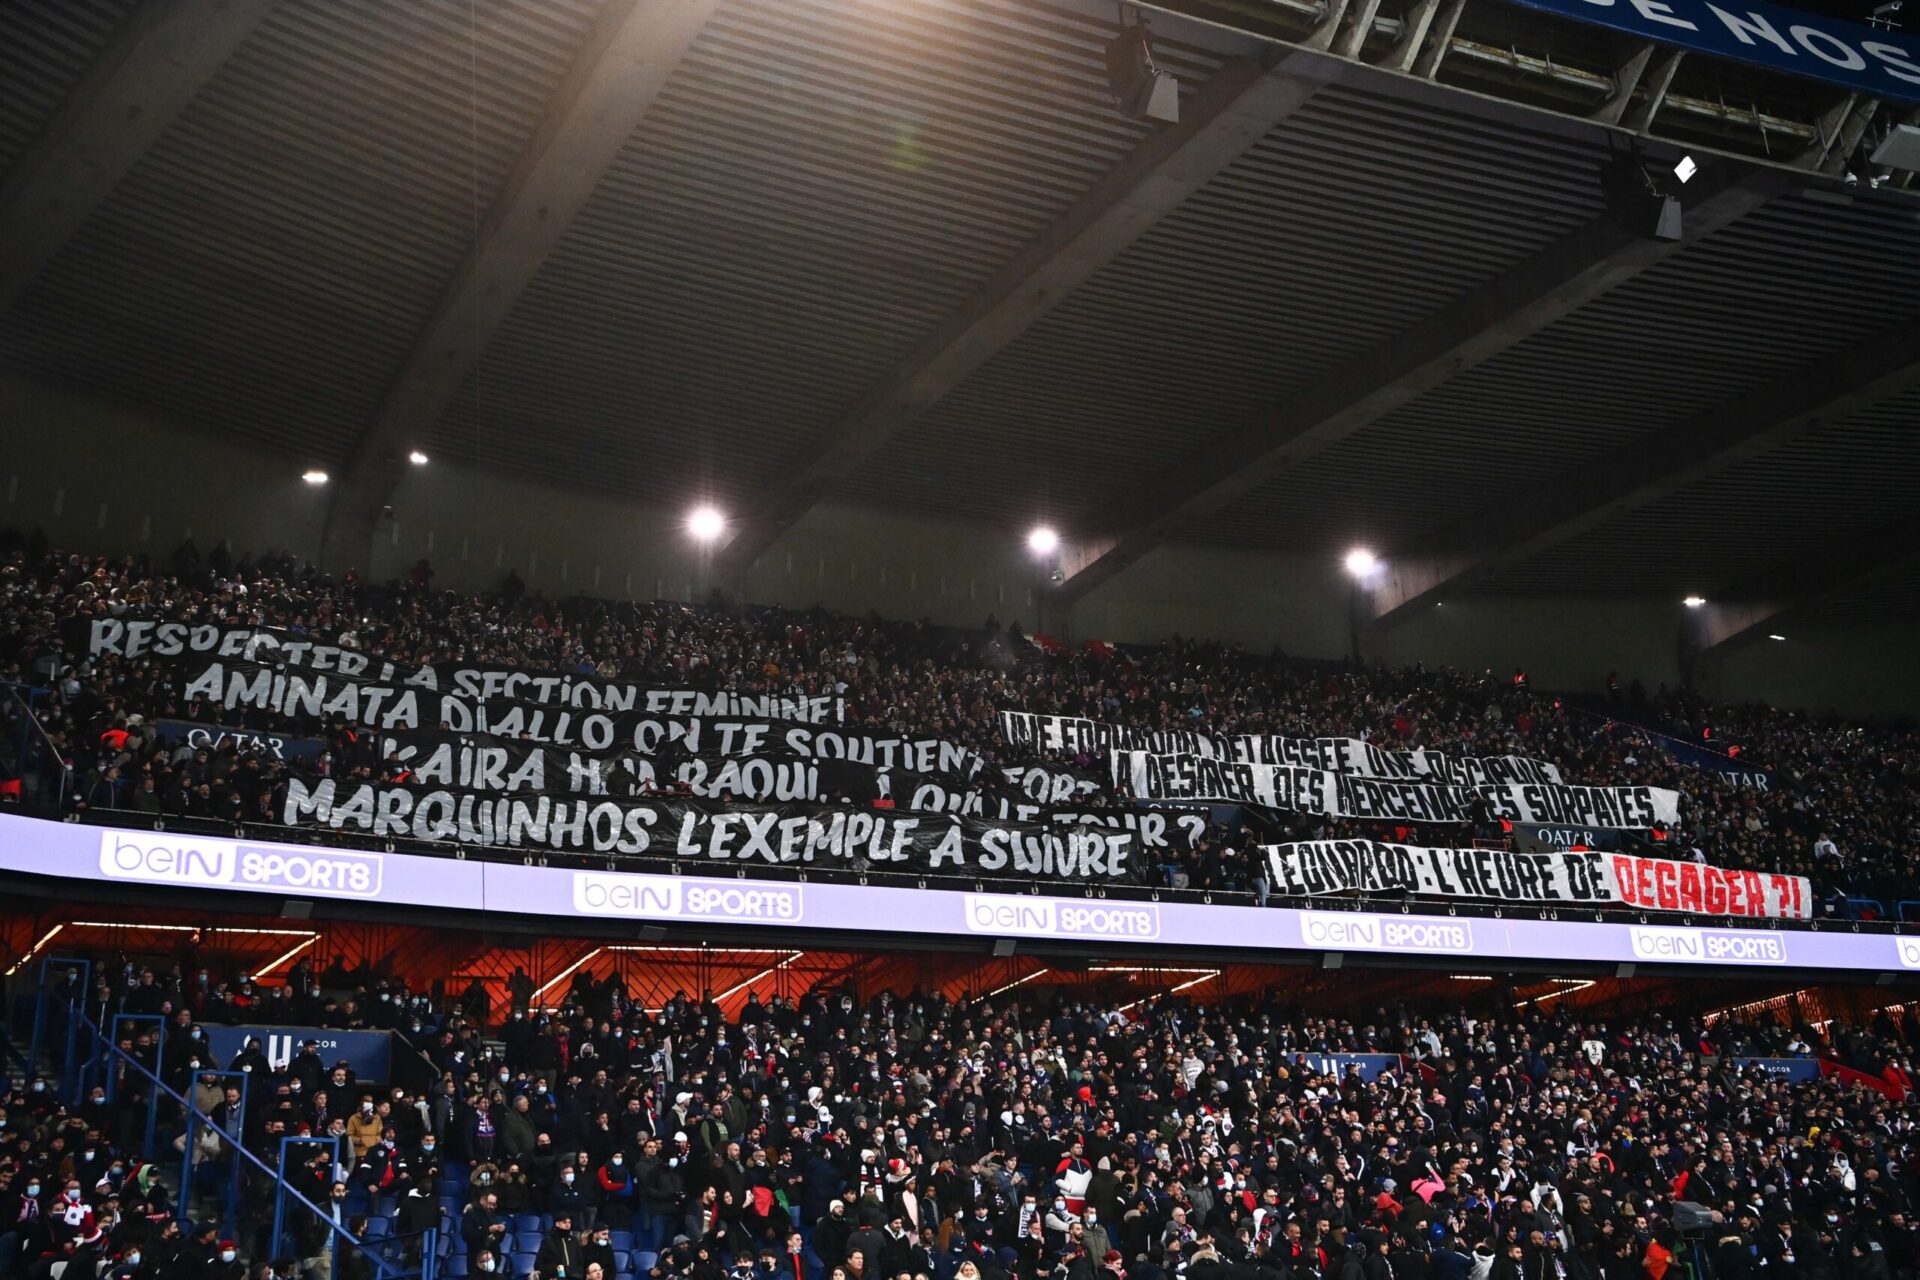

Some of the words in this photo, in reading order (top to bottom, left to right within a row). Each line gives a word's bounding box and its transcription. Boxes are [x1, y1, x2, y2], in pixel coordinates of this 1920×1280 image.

[184, 662, 418, 730] AMINATA
[441, 696, 614, 750] DIALLO
[1273, 766, 1324, 814] DES
[1335, 774, 1522, 822] MERCENAIES
[1523, 786, 1655, 827] SURPAYES
[283, 777, 658, 854] MARQUINHOS
[676, 810, 920, 864] L'EXEMPLE
[978, 825, 1133, 878] SUIVRE
[115, 835, 223, 877] beIN
[241, 852, 371, 891] SPORTS
[1563, 853, 1611, 900] DE
[1612, 855, 1766, 918] DEGAGER
[585, 876, 671, 911] beIN
[687, 887, 794, 918] SPORTS
[974, 898, 1048, 929] beIN
[1060, 907, 1152, 935] SPORTS
[1308, 914, 1375, 944] beIN
[1384, 923, 1466, 947] SPORTS
[1637, 932, 1698, 956] beIN
[1707, 936, 1780, 960] SPORTS
